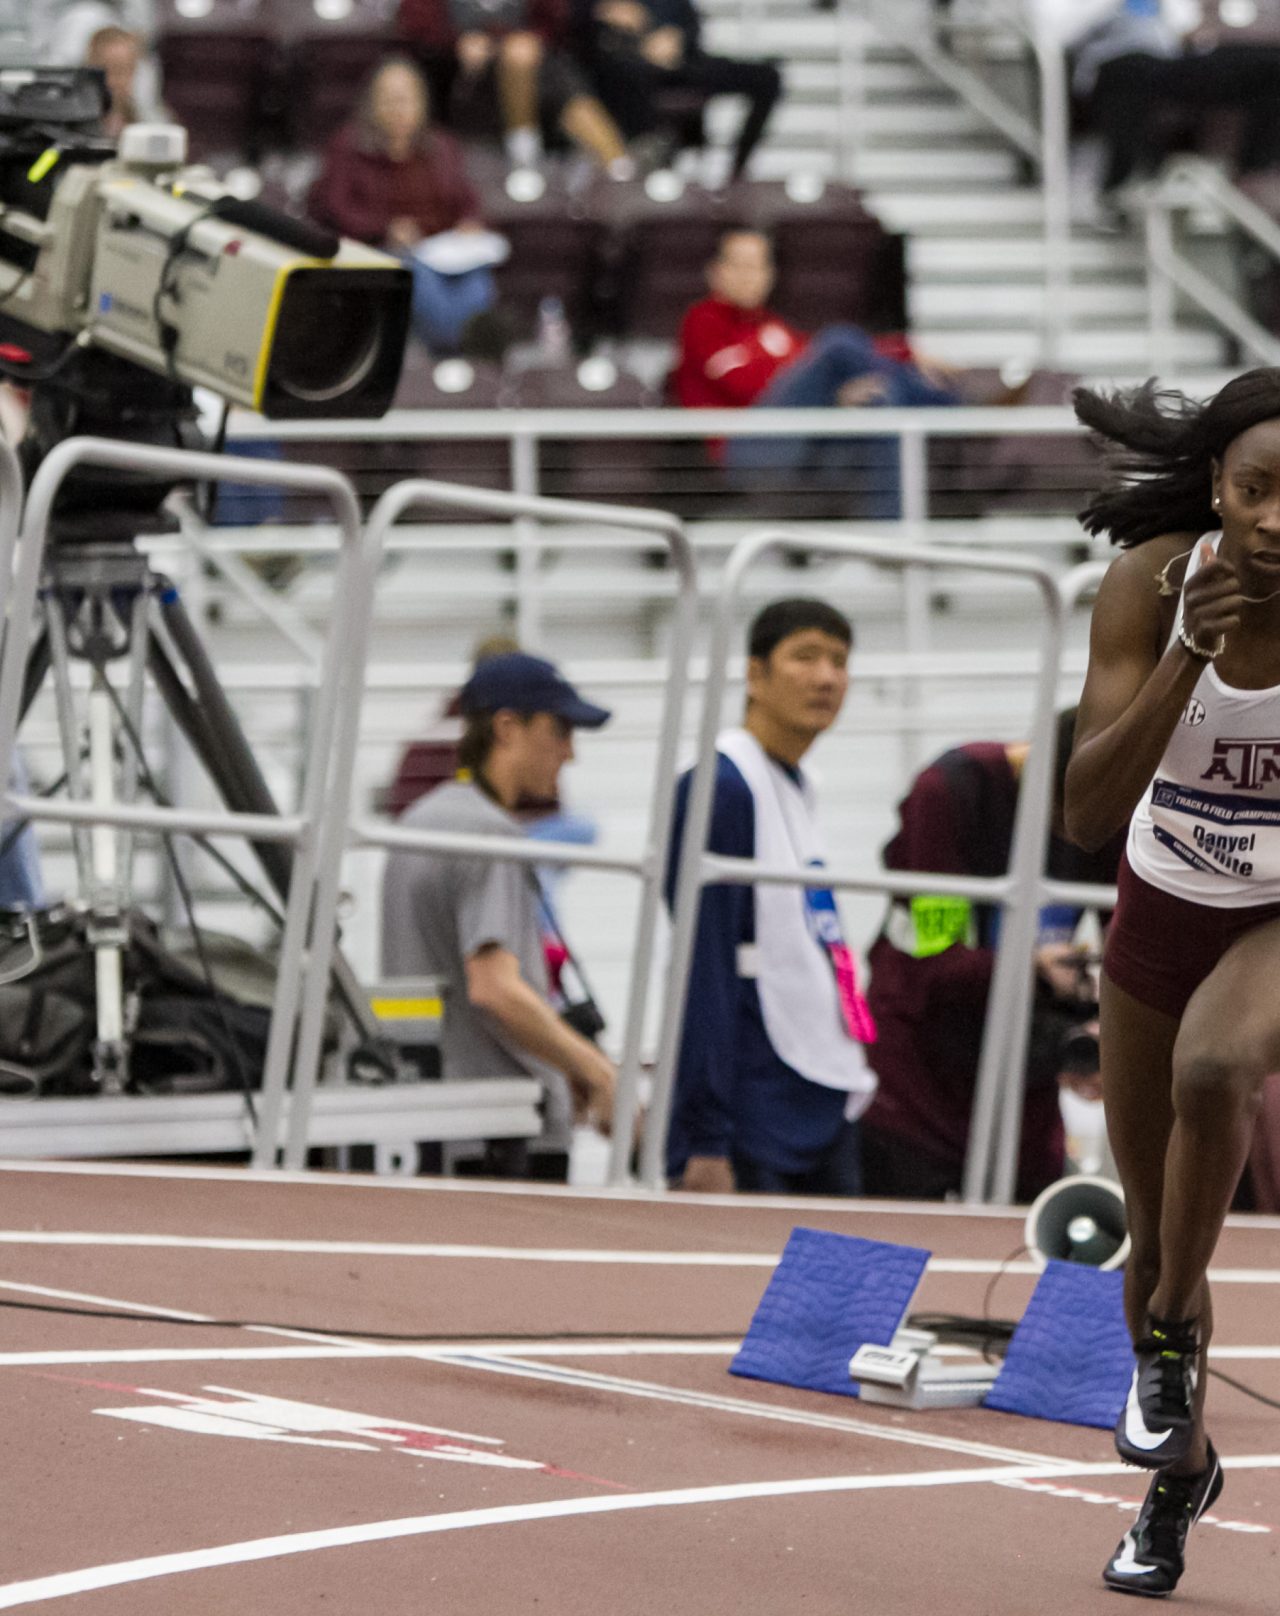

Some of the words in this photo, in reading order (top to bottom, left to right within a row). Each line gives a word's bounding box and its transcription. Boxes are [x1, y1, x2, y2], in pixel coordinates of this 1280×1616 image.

[1181, 699, 1205, 727] EC
[1175, 796, 1200, 810] TRACK
[1209, 805, 1233, 819] FIELD
[1193, 824, 1256, 852] Danyel
